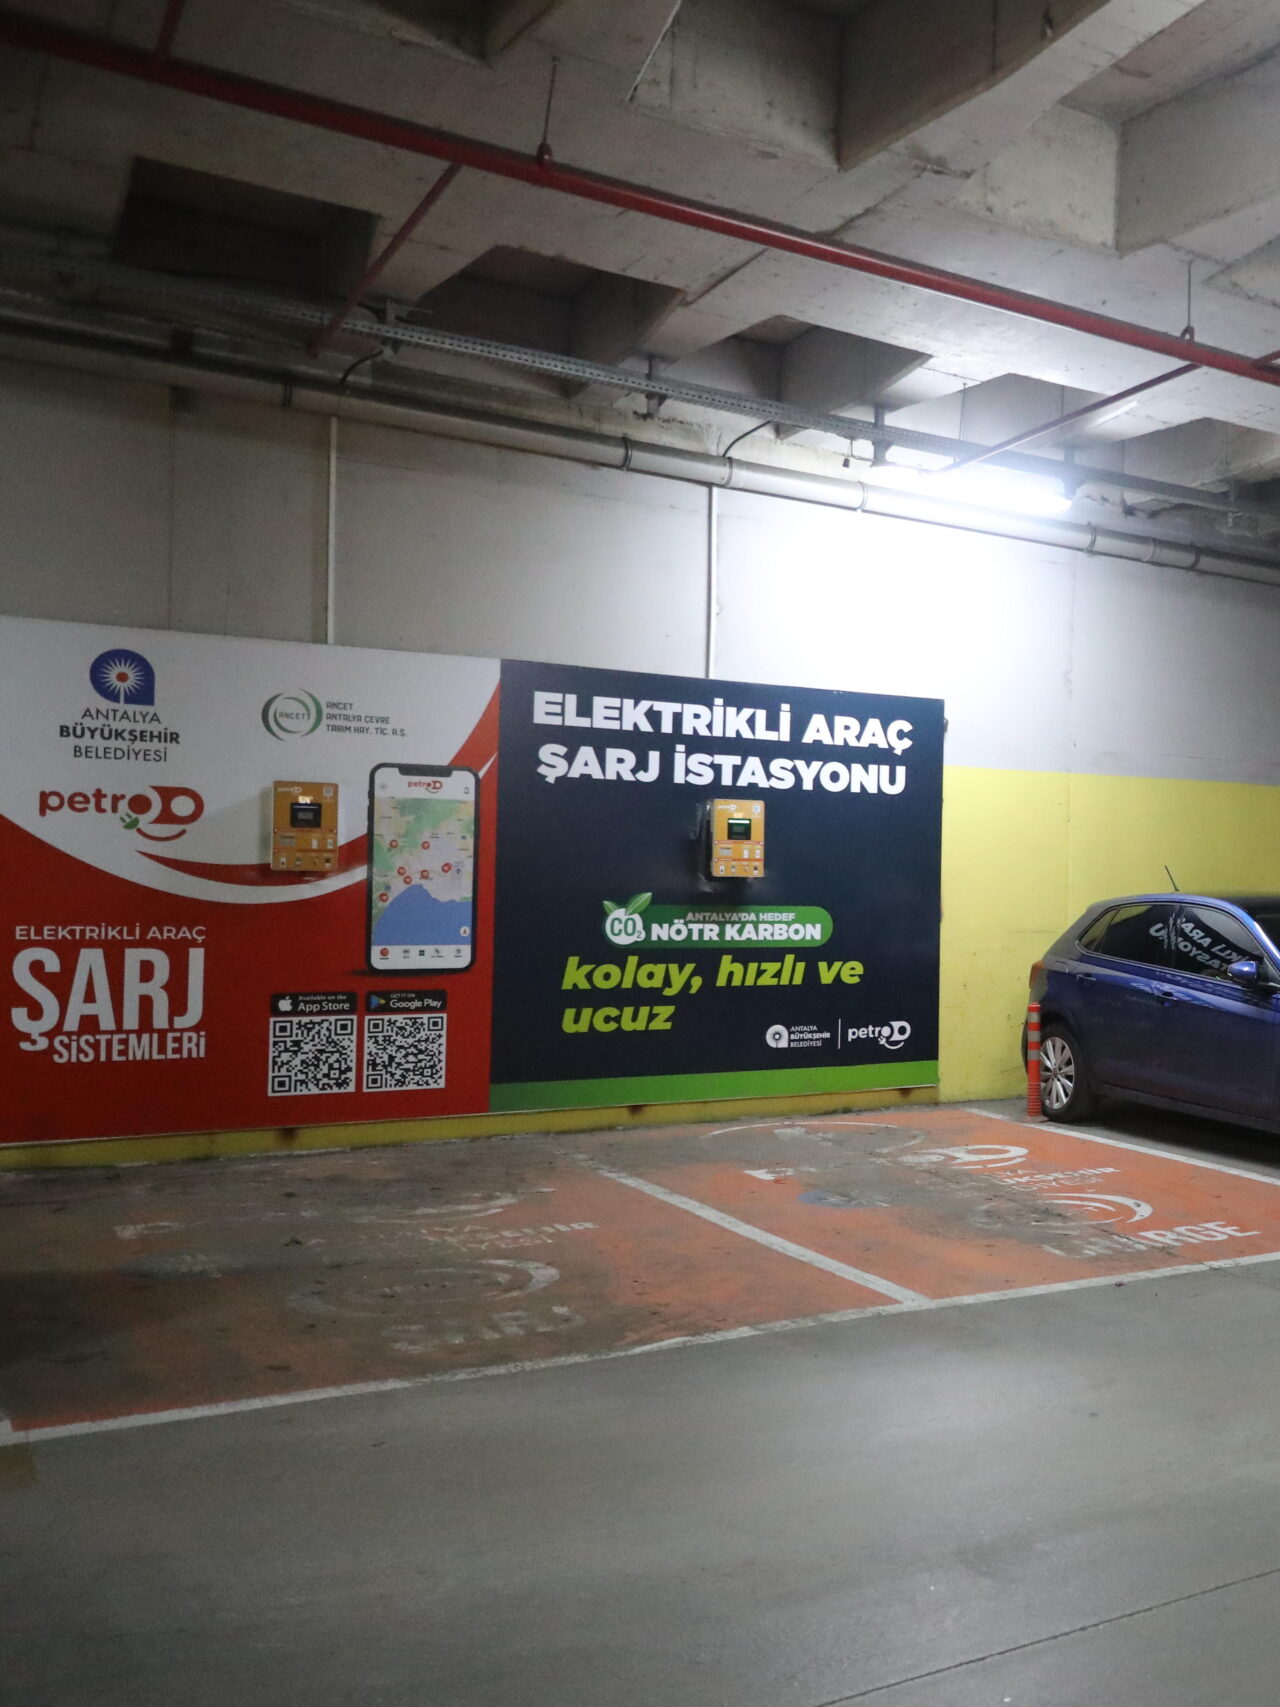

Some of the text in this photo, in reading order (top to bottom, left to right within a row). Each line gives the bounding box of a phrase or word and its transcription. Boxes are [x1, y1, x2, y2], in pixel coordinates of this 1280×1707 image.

[81, 707, 161, 724] ANTALYA
[533, 690, 914, 756] ELEKTRİKLİ ARAÇ
[59, 722, 180, 745] BÜYÜKŞEHİR
[73, 745, 167, 762] BELEDİYESİ
[536, 743, 906, 795] ŞARJ İSTASYONU
[759, 912, 796, 922] HEDEF
[15, 923, 206, 943] ELEKTRİKLİ ARAÇ
[651, 919, 822, 942] NÖTR KARBON
[561, 954, 865, 997] kolay, hızlı ve
[11, 947, 205, 1051] ŞARJ
[298, 1001, 350, 1013] App Store
[390, 999, 442, 1010] Google Play
[561, 1005, 677, 1034] ucuz
[53, 1031, 206, 1063] SİSTEMLERİ
[790, 1039, 822, 1048] BELEDİYESİ
